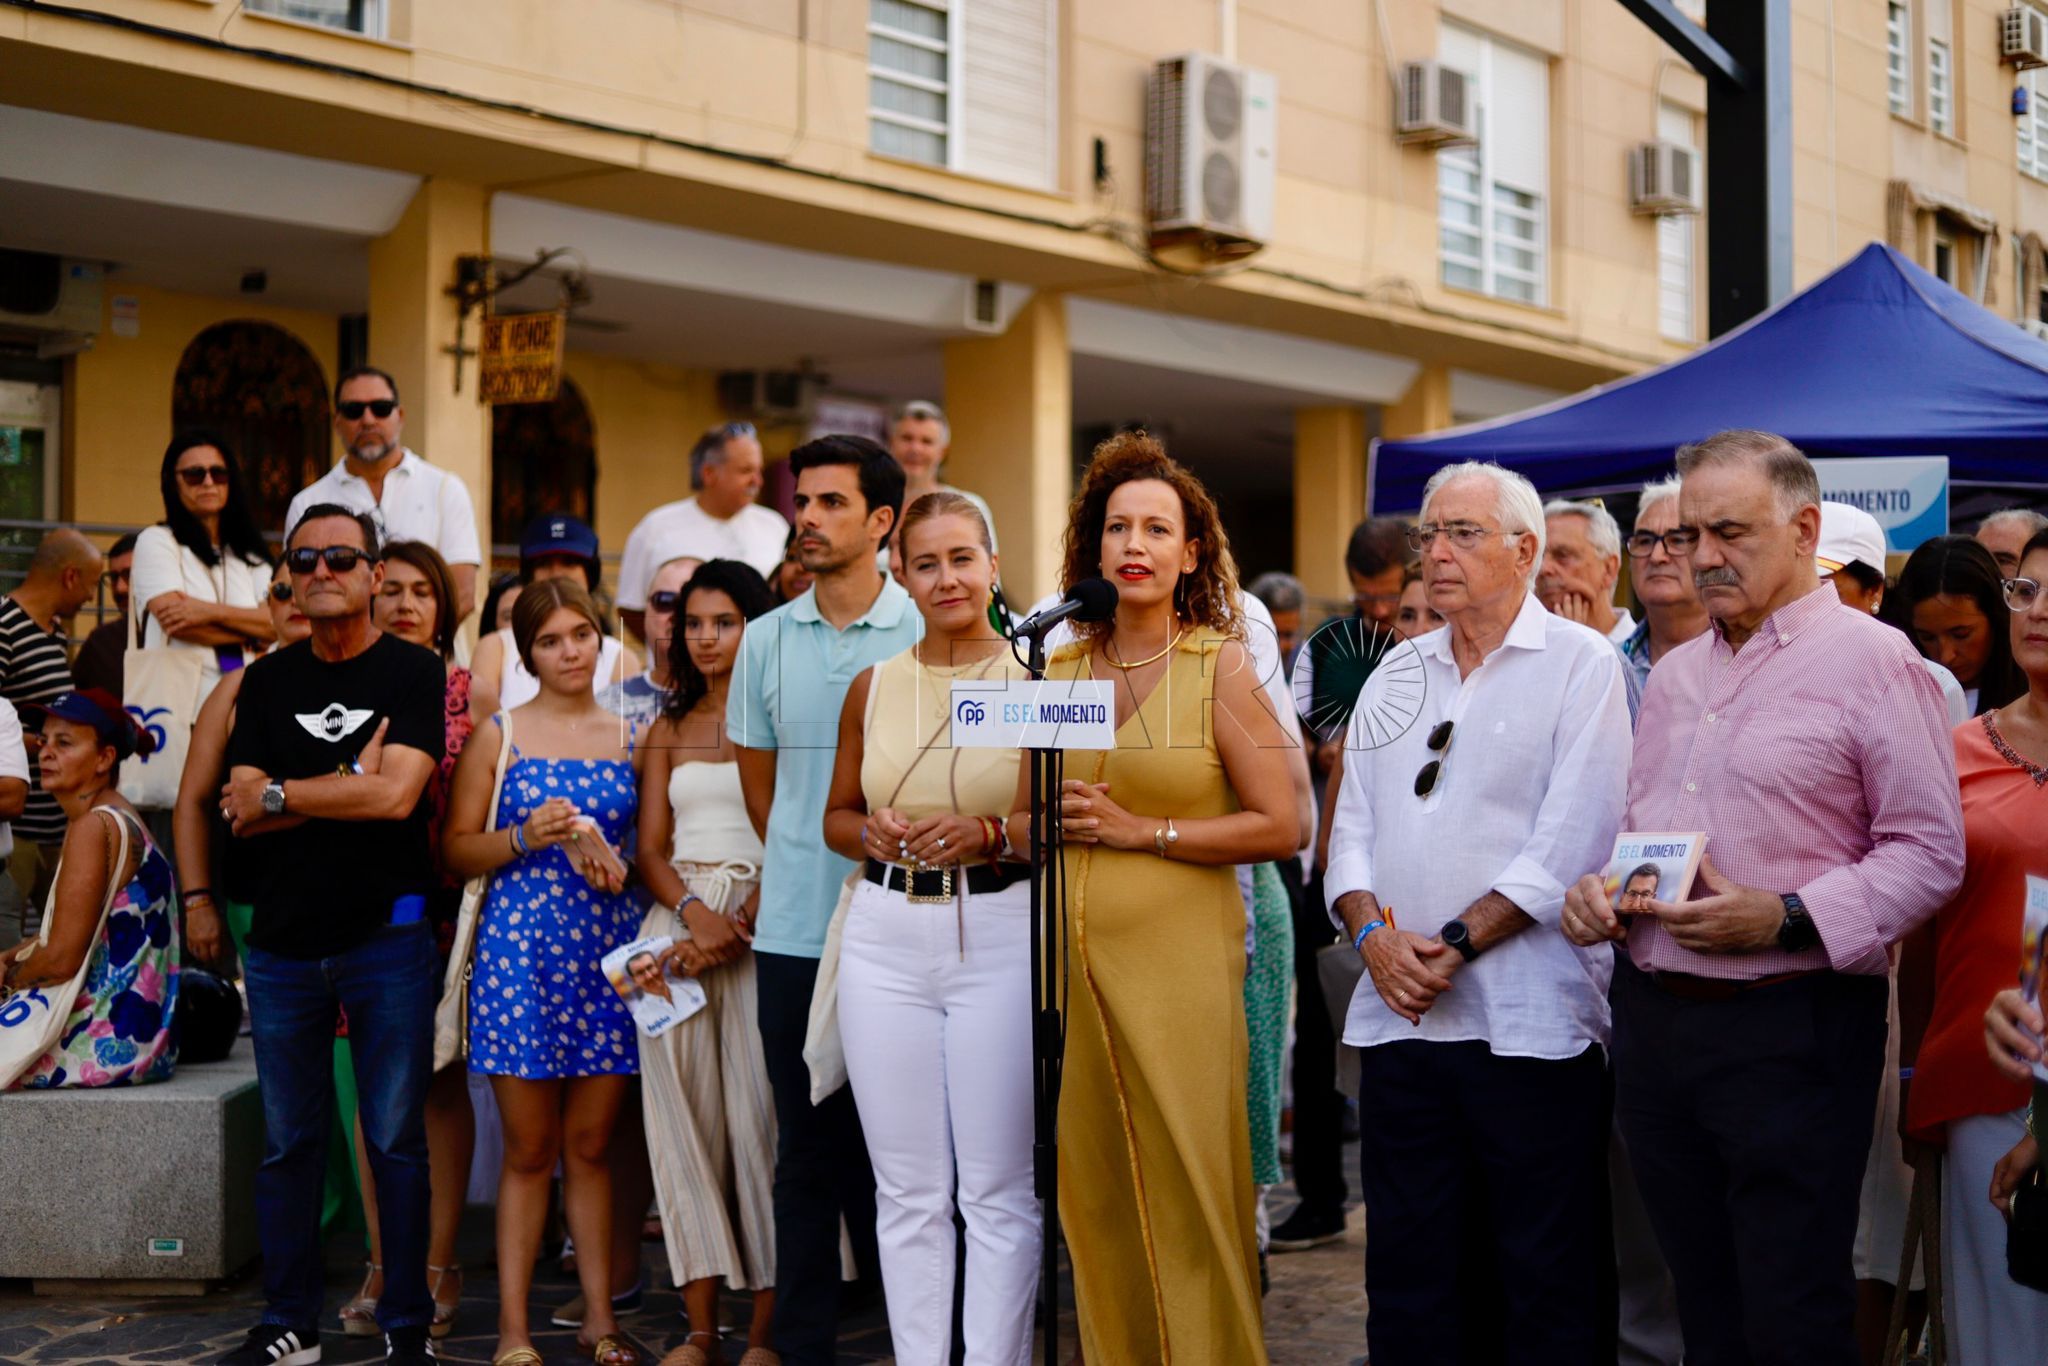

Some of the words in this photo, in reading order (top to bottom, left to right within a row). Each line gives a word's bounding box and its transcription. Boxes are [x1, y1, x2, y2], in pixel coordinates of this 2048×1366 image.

[1003, 703, 1019, 723] ES
[1022, 703, 1036, 723] EL
[1040, 703, 1106, 724] MOMENTO
[325, 715, 344, 730] MINI
[1618, 845, 1630, 859] ES
[1630, 844, 1640, 858] EL
[1641, 843, 1687, 858] MOMENTO
